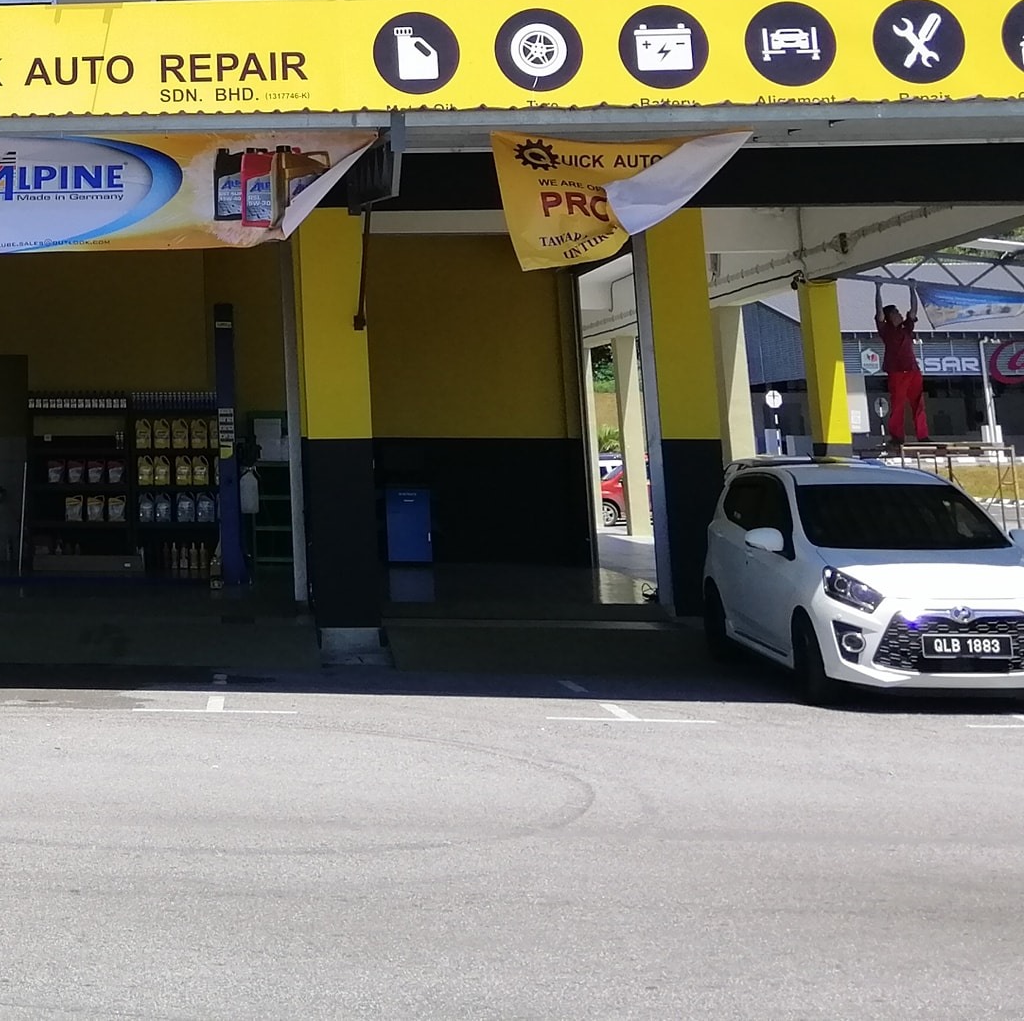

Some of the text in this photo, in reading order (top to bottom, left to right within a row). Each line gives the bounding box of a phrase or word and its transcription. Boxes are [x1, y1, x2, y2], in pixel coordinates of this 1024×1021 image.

[24, 55, 135, 86] AUTO
[160, 51, 308, 83] REPAIR
[160, 88, 203, 103] SDN.
[215, 86, 259, 102] BHD.
[539, 179, 558, 187] WE
[561, 180, 584, 189] ARE
[55, 193, 65, 201] in
[69, 193, 124, 201] Germany
[916, 356, 981, 372] SAR
[934, 638, 1000, 653] QLB 1883
